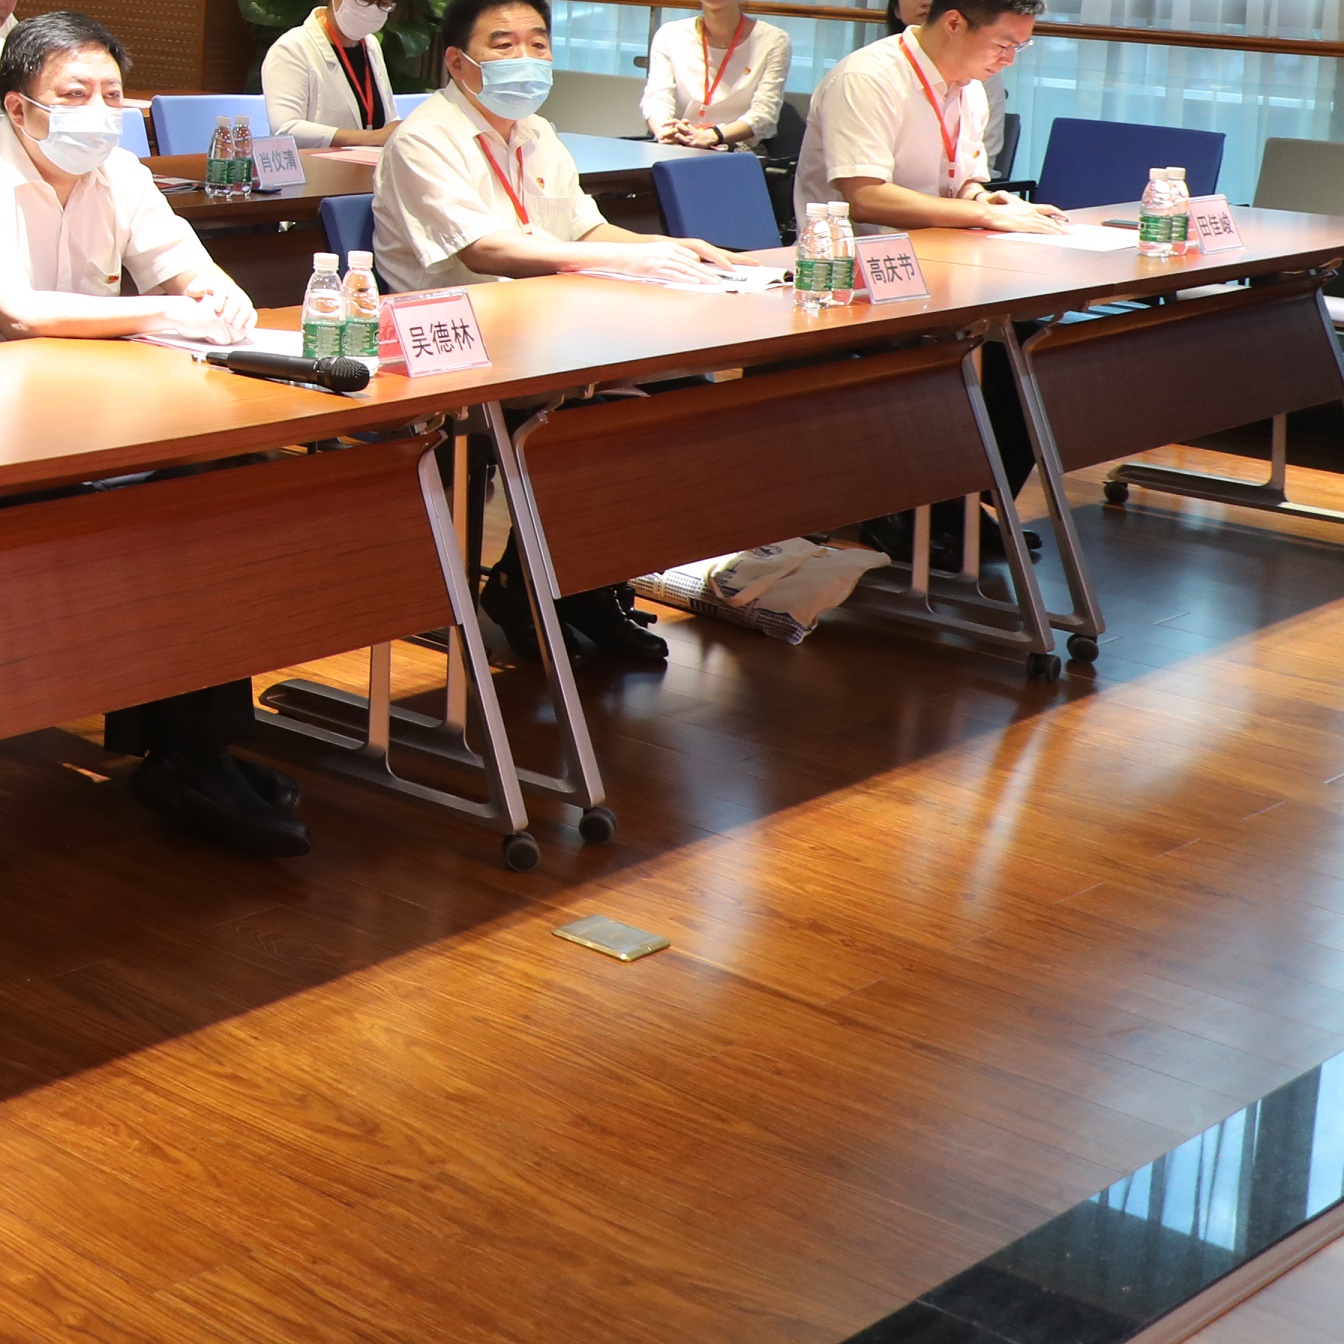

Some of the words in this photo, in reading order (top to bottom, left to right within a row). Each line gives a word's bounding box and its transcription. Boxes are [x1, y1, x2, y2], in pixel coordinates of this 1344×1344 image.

[259, 149, 298, 174] 肖仪清
[866, 253, 916, 285] 高庆节
[408, 317, 476, 360] 吴德林
